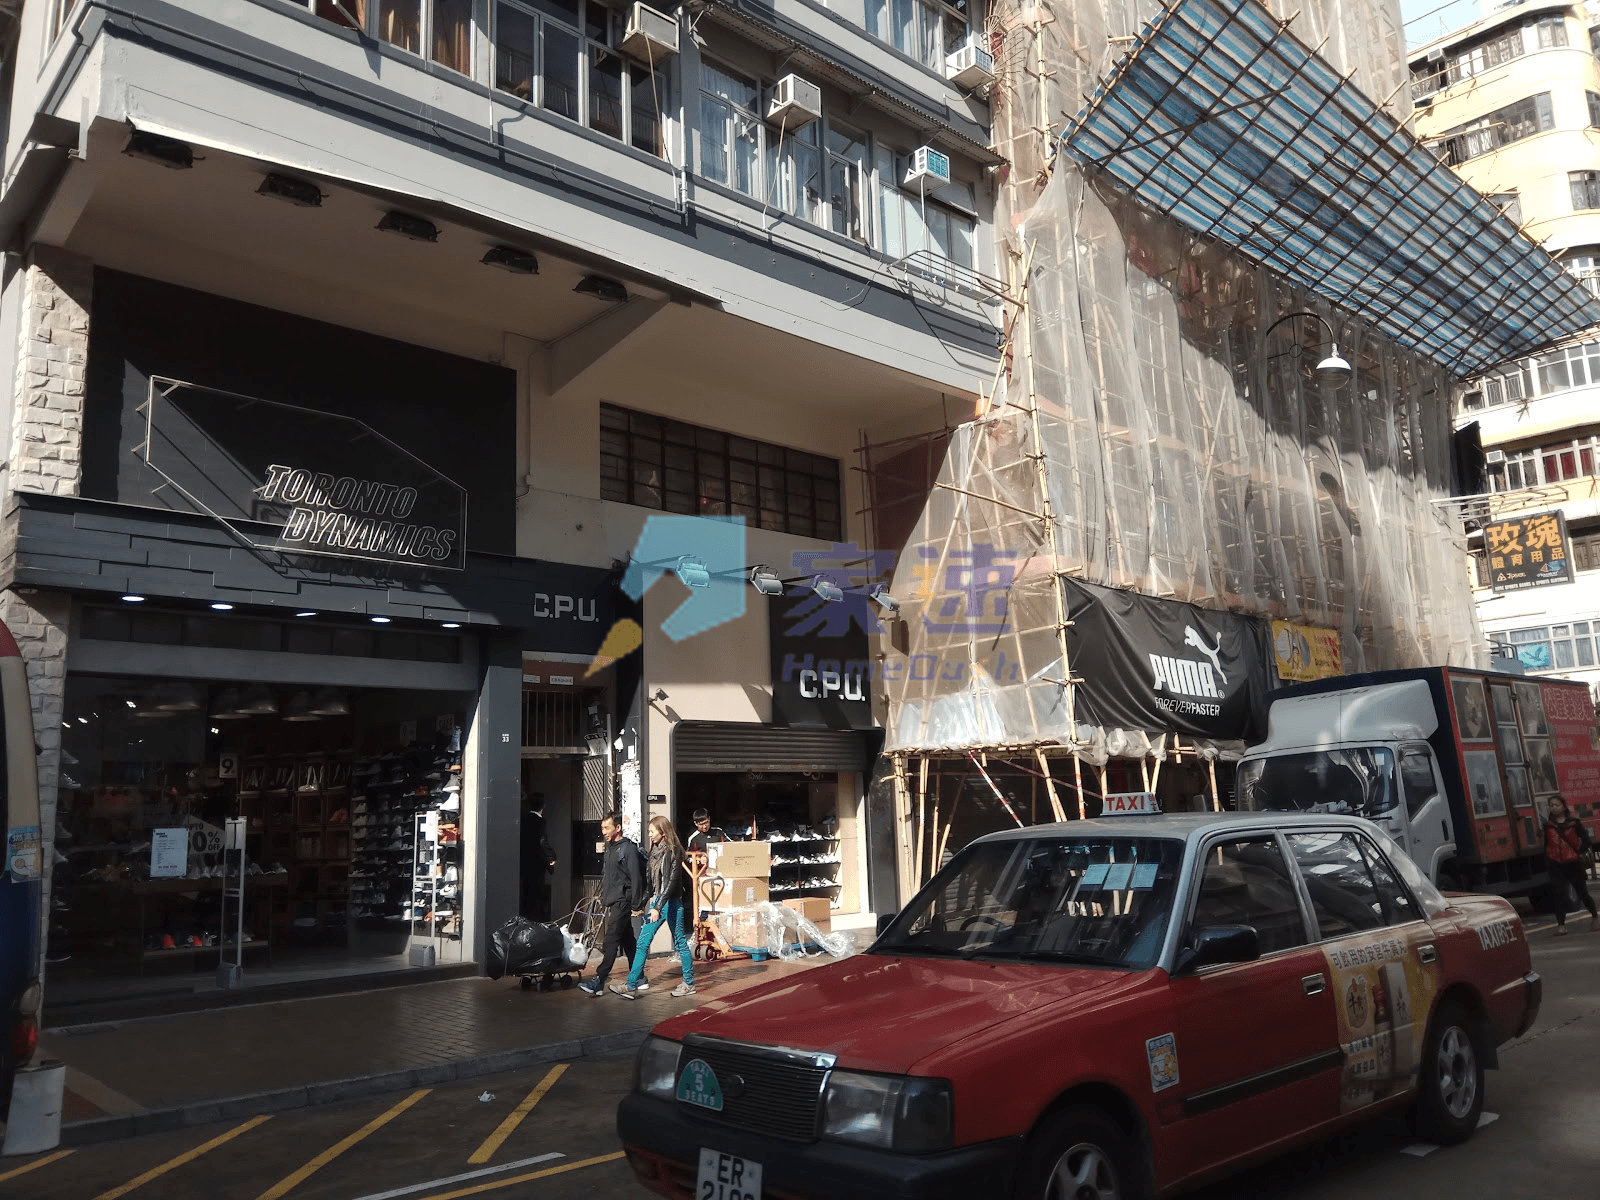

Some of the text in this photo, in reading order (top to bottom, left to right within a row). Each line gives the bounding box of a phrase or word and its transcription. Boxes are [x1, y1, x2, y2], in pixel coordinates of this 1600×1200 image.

[263, 464, 418, 519] TORONTO
[282, 507, 457, 561] DYNAMICS
[1487, 516, 1562, 555] 玫瑰
[533, 593, 600, 622] C.P.U.
[799, 669, 866, 701] C.P.U.
[1149, 653, 1219, 698] PUMA
[1105, 795, 1145, 812] TAXI
[685, 1089, 716, 1106] SEATS
[694, 1073, 705, 1092] 5
[717, 1153, 744, 1188] ER
